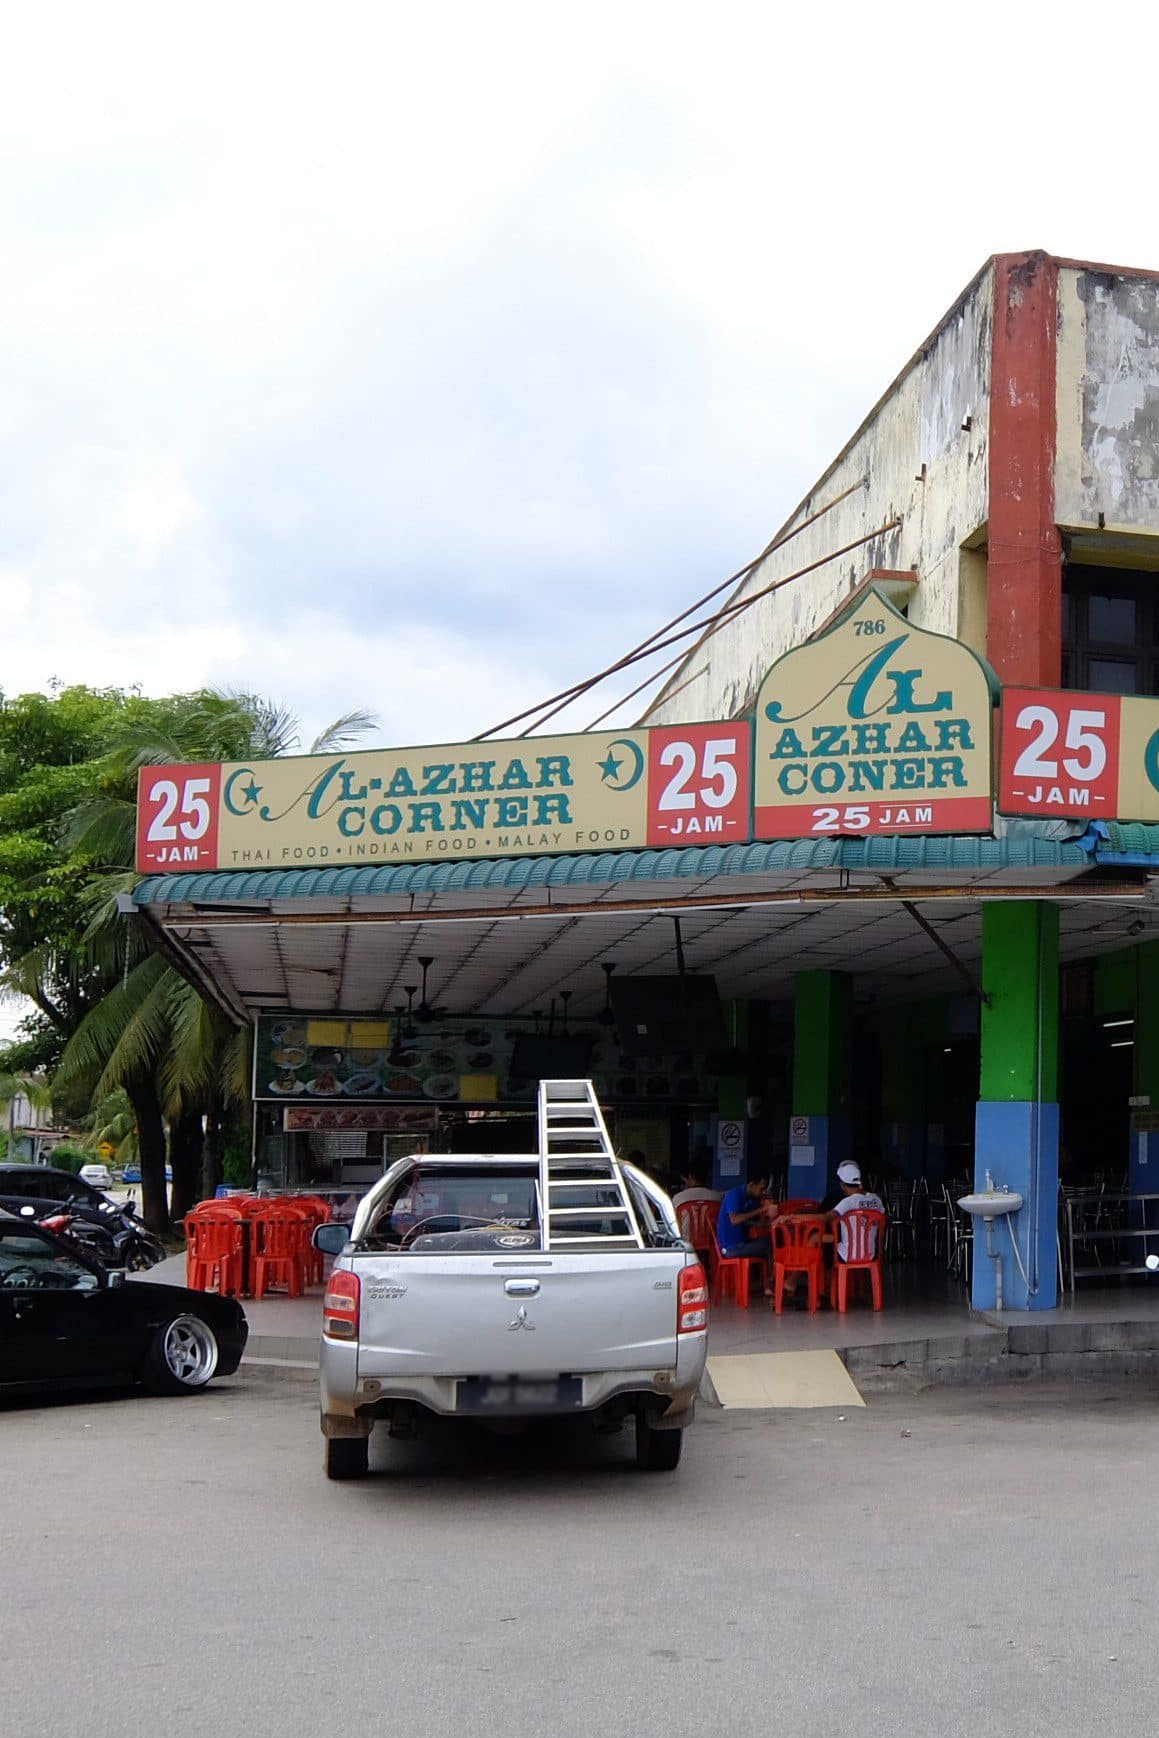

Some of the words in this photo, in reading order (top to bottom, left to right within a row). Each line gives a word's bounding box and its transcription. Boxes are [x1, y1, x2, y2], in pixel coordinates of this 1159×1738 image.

[853, 619, 886, 636] 786
[765, 633, 953, 724] AL
[769, 719, 975, 759] AZHAR
[1013, 705, 1107, 781] 25
[259, 755, 574, 822] AL-AZHAR
[657, 738, 738, 811] 25
[777, 755, 968, 796] CONER
[147, 778, 211, 842] 25
[337, 793, 573, 837] CORNER
[811, 806, 871, 831] 25
[879, 807, 933, 825] JAM
[231, 850, 270, 862] THAI
[282, 846, 329, 859] FOOD
[348, 841, 413, 856] INDIAN
[425, 838, 477, 851] FOOD
[498, 832, 562, 847] MALAY
[575, 828, 631, 843] FOOD
